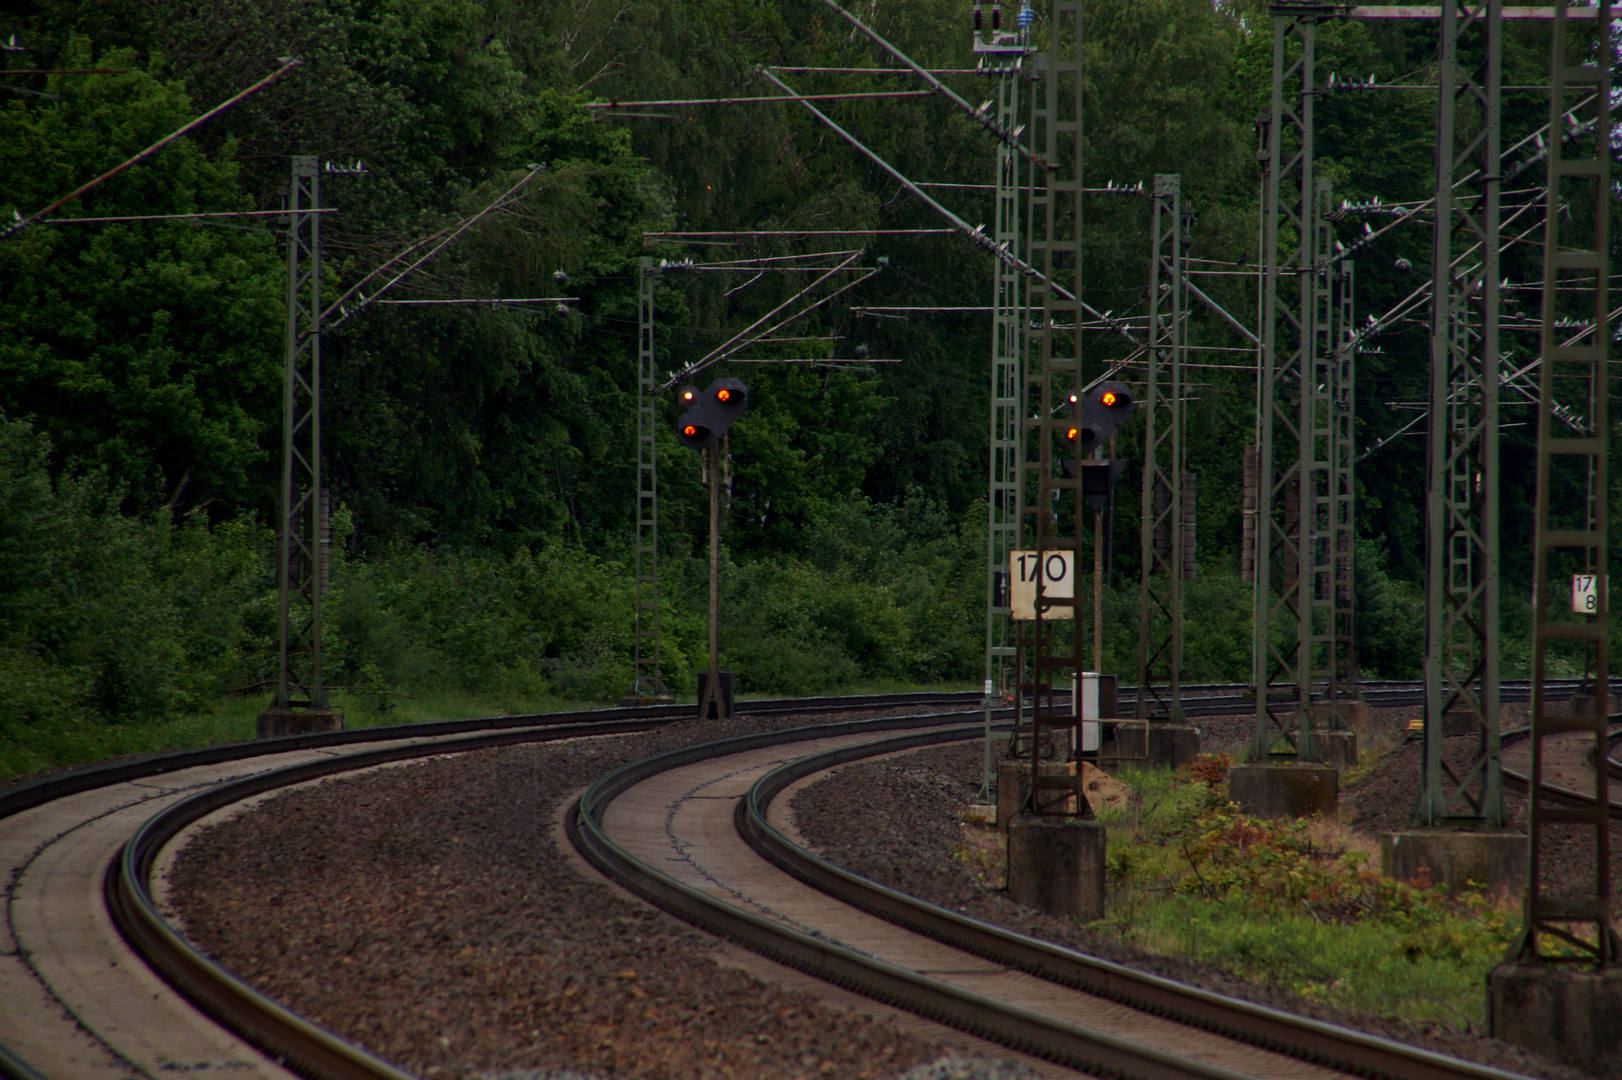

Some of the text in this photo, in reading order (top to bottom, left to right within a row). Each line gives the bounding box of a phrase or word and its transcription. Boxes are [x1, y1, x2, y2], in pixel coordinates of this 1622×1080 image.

[1017, 554, 1067, 582] 170
[1576, 576, 1593, 592] 17
[1586, 594, 1596, 610] 8
